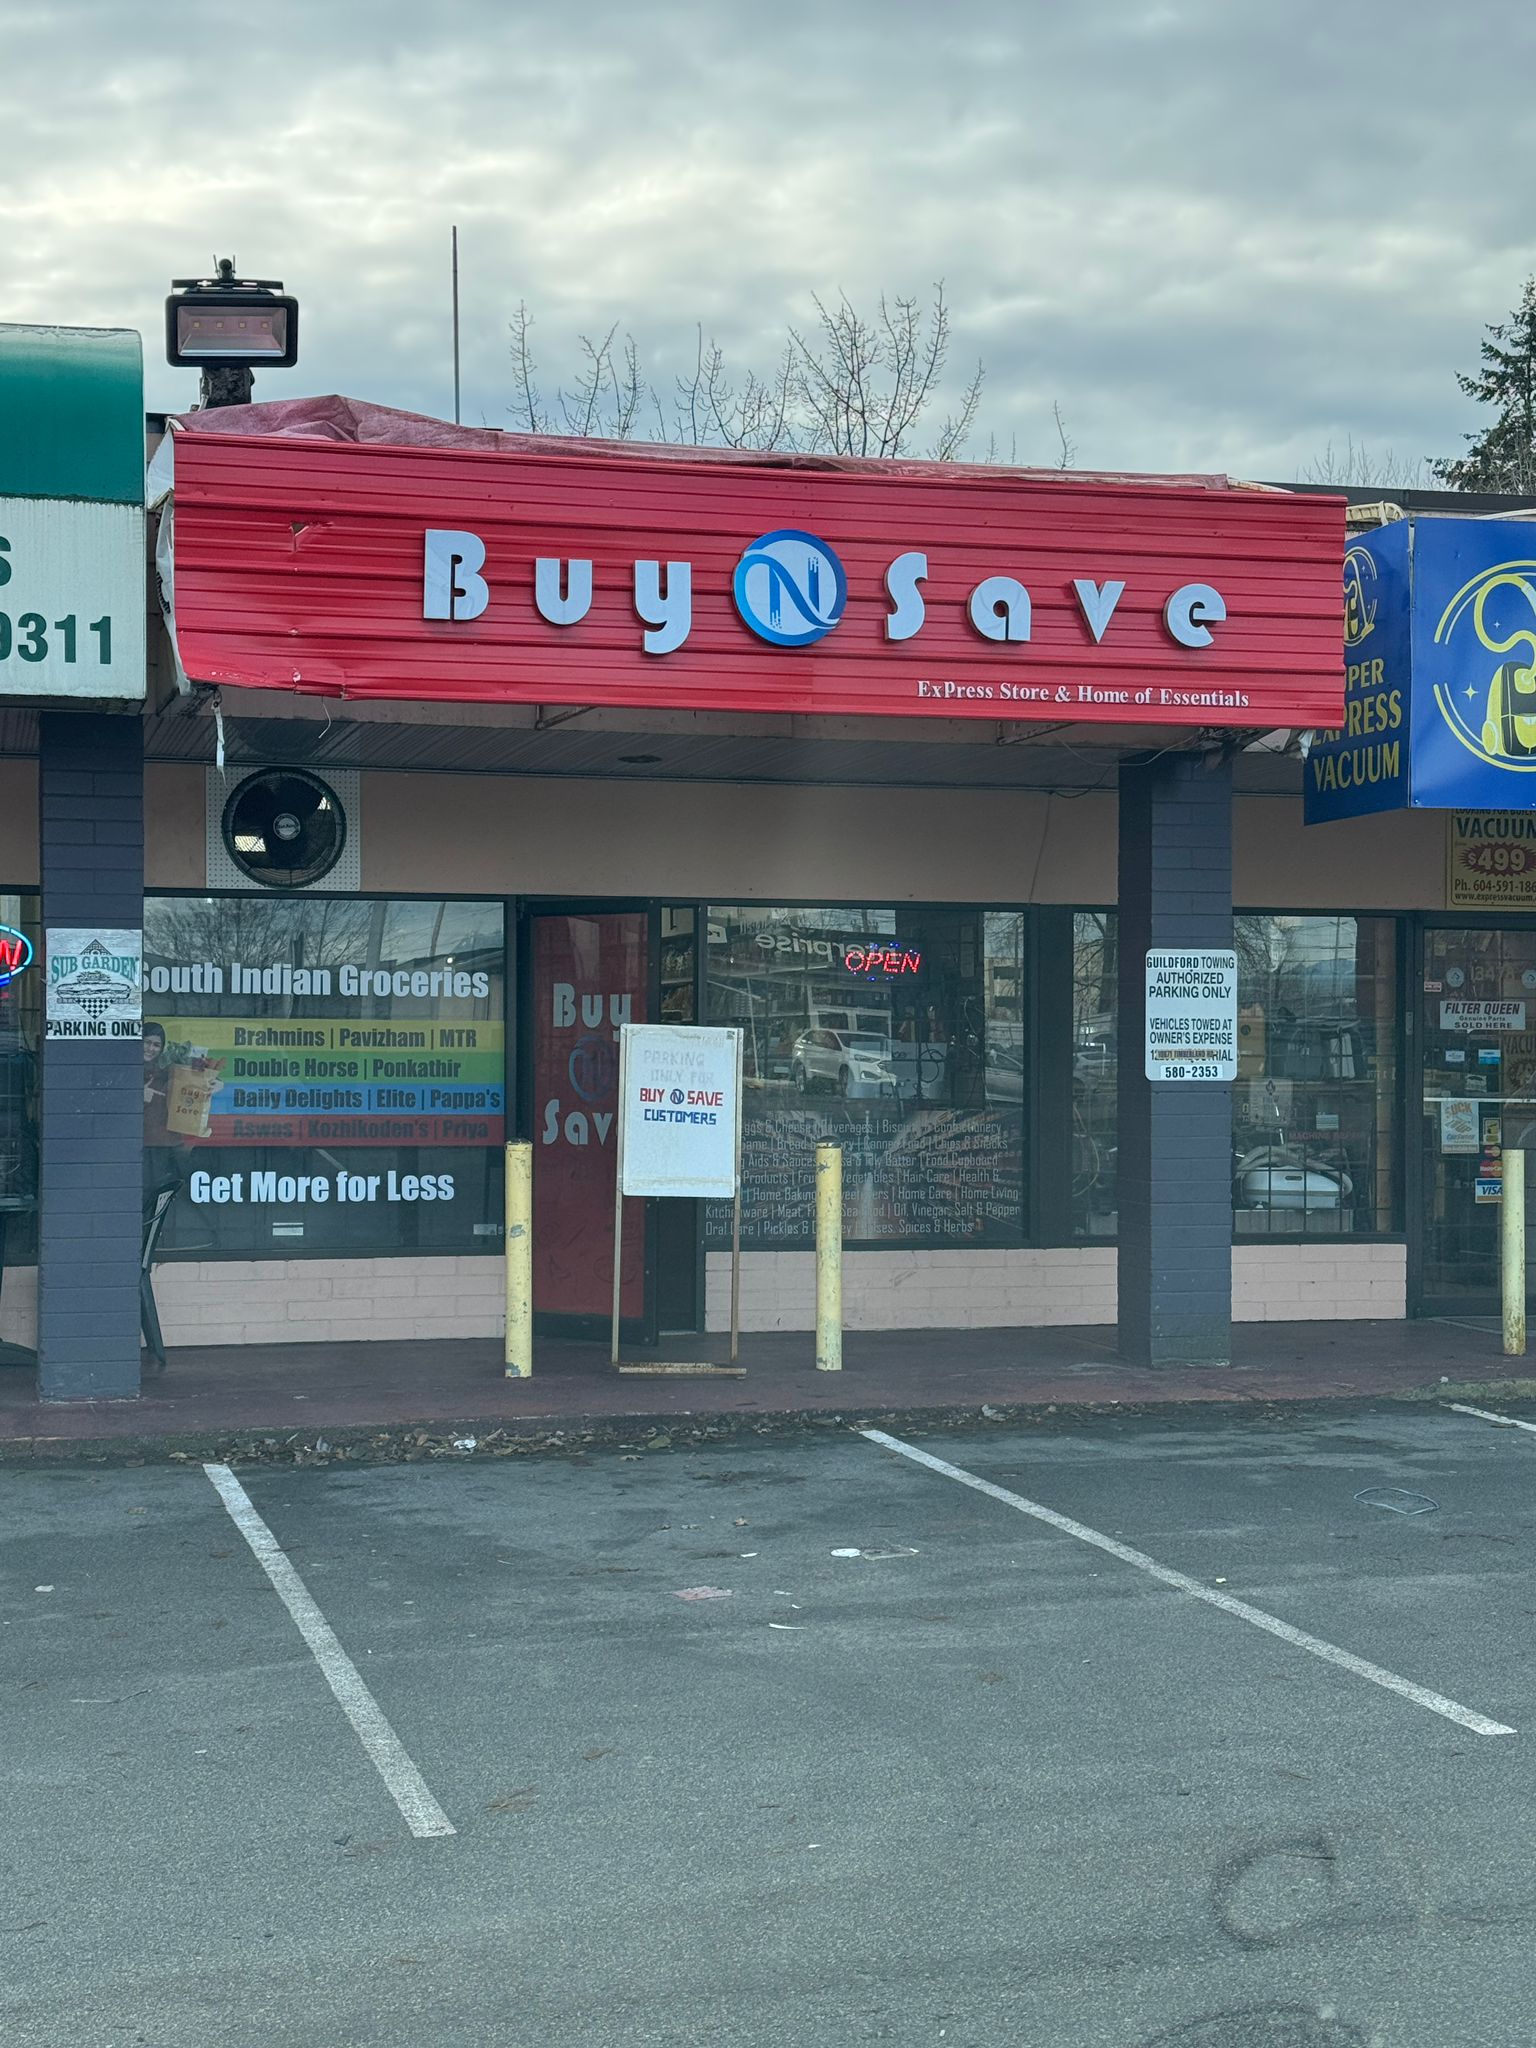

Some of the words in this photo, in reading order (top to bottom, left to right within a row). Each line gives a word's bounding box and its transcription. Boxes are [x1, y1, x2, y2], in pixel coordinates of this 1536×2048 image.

[423, 529, 692, 654] Buy
[885, 551, 1226, 648] Save
[1343, 658, 1385, 692] PER
[999, 682, 1049, 700] Store
[1054, 686, 1071, 703] &
[1077, 685, 1129, 704] Home
[1134, 687, 1153, 705] of
[1160, 688, 1249, 707] Essentials
[1313, 740, 1400, 792] VACUUM
[1467, 848, 1525, 871] $499
[1455, 879, 1470, 891] Ph.
[51, 955, 78, 984] SUB
[81, 956, 139, 982] GARDEN
[845, 951, 921, 974] OPEN
[1146, 957, 1199, 969] GUILDFORD
[1200, 957, 1235, 969] TOWING
[231, 962, 331, 996] Indian
[339, 965, 489, 998] Groceries
[1156, 972, 1224, 984] AUTHORIZED
[1149, 986, 1199, 998] PARKING
[1202, 986, 1232, 998] ONLY
[553, 983, 632, 1042] Buy
[1445, 1003, 1481, 1014] FILTER
[1484, 1003, 1520, 1015] QUEEN
[46, 1021, 106, 1037] PARKING
[1149, 1018, 1189, 1030] VEHICLES
[1191, 1018, 1221, 1031] TOWED
[1222, 1019, 1233, 1031] AT
[234, 1027, 325, 1047] Brahmins
[339, 1028, 425, 1048] Pavizham
[440, 1029, 477, 1048] MTR
[1149, 1032, 1191, 1044] OWNER'S
[1193, 1032, 1233, 1045] EXPENSE
[644, 1050, 705, 1067] PARKING
[234, 1058, 300, 1078] Double
[304, 1058, 358, 1078] Horse
[373, 1059, 461, 1079] Ponkathir
[1165, 1066, 1218, 1078] 580-2353
[233, 1088, 281, 1111] Daily
[285, 1088, 362, 1111] Delights
[376, 1089, 416, 1108] Elite
[430, 1089, 500, 1111] Pappa's
[640, 1088, 665, 1103] BUY
[687, 1090, 724, 1106] SAVE
[542, 1098, 618, 1146] Sav
[644, 1108, 717, 1125] CUSTOMERS
[234, 1120, 292, 1139] Aswas
[308, 1120, 428, 1140] Kozhikoden's
[442, 1120, 489, 1141] Priya
[741, 1122, 761, 1136] ggs
[776, 1119, 811, 1134] Cheese
[749, 1153, 769, 1167] Aids
[773, 1152, 779, 1167] &
[782, 1152, 817, 1167] Sauces
[886, 1152, 917, 1167] Batter
[926, 1152, 949, 1167] Food
[952, 1152, 998, 1168] Cupboard
[743, 1169, 789, 1185] Products
[903, 1168, 925, 1183] Hair
[927, 1168, 951, 1183] Care
[960, 1167, 990, 1183] Health
[993, 1168, 999, 1183] &
[190, 1171, 243, 1203] Get
[250, 1171, 329, 1203] More
[336, 1171, 380, 1202] for
[387, 1170, 455, 1201] Less
[753, 1187, 781, 1201] Home
[898, 1186, 926, 1200] Home
[929, 1185, 952, 1200] Care
[961, 1186, 989, 1200] Home
[991, 1185, 1020, 1202] Living
[955, 1201, 974, 1216] Salt
[976, 1201, 983, 1216] &
[986, 1201, 1020, 1218] Pepper
[705, 1221, 727, 1236] Oral
[764, 1220, 800, 1236] Pickles
[802, 1220, 809, 1236] &
[897, 1219, 931, 1237] Spices
[934, 1219, 941, 1233] &
[944, 1218, 973, 1233] Herbs
